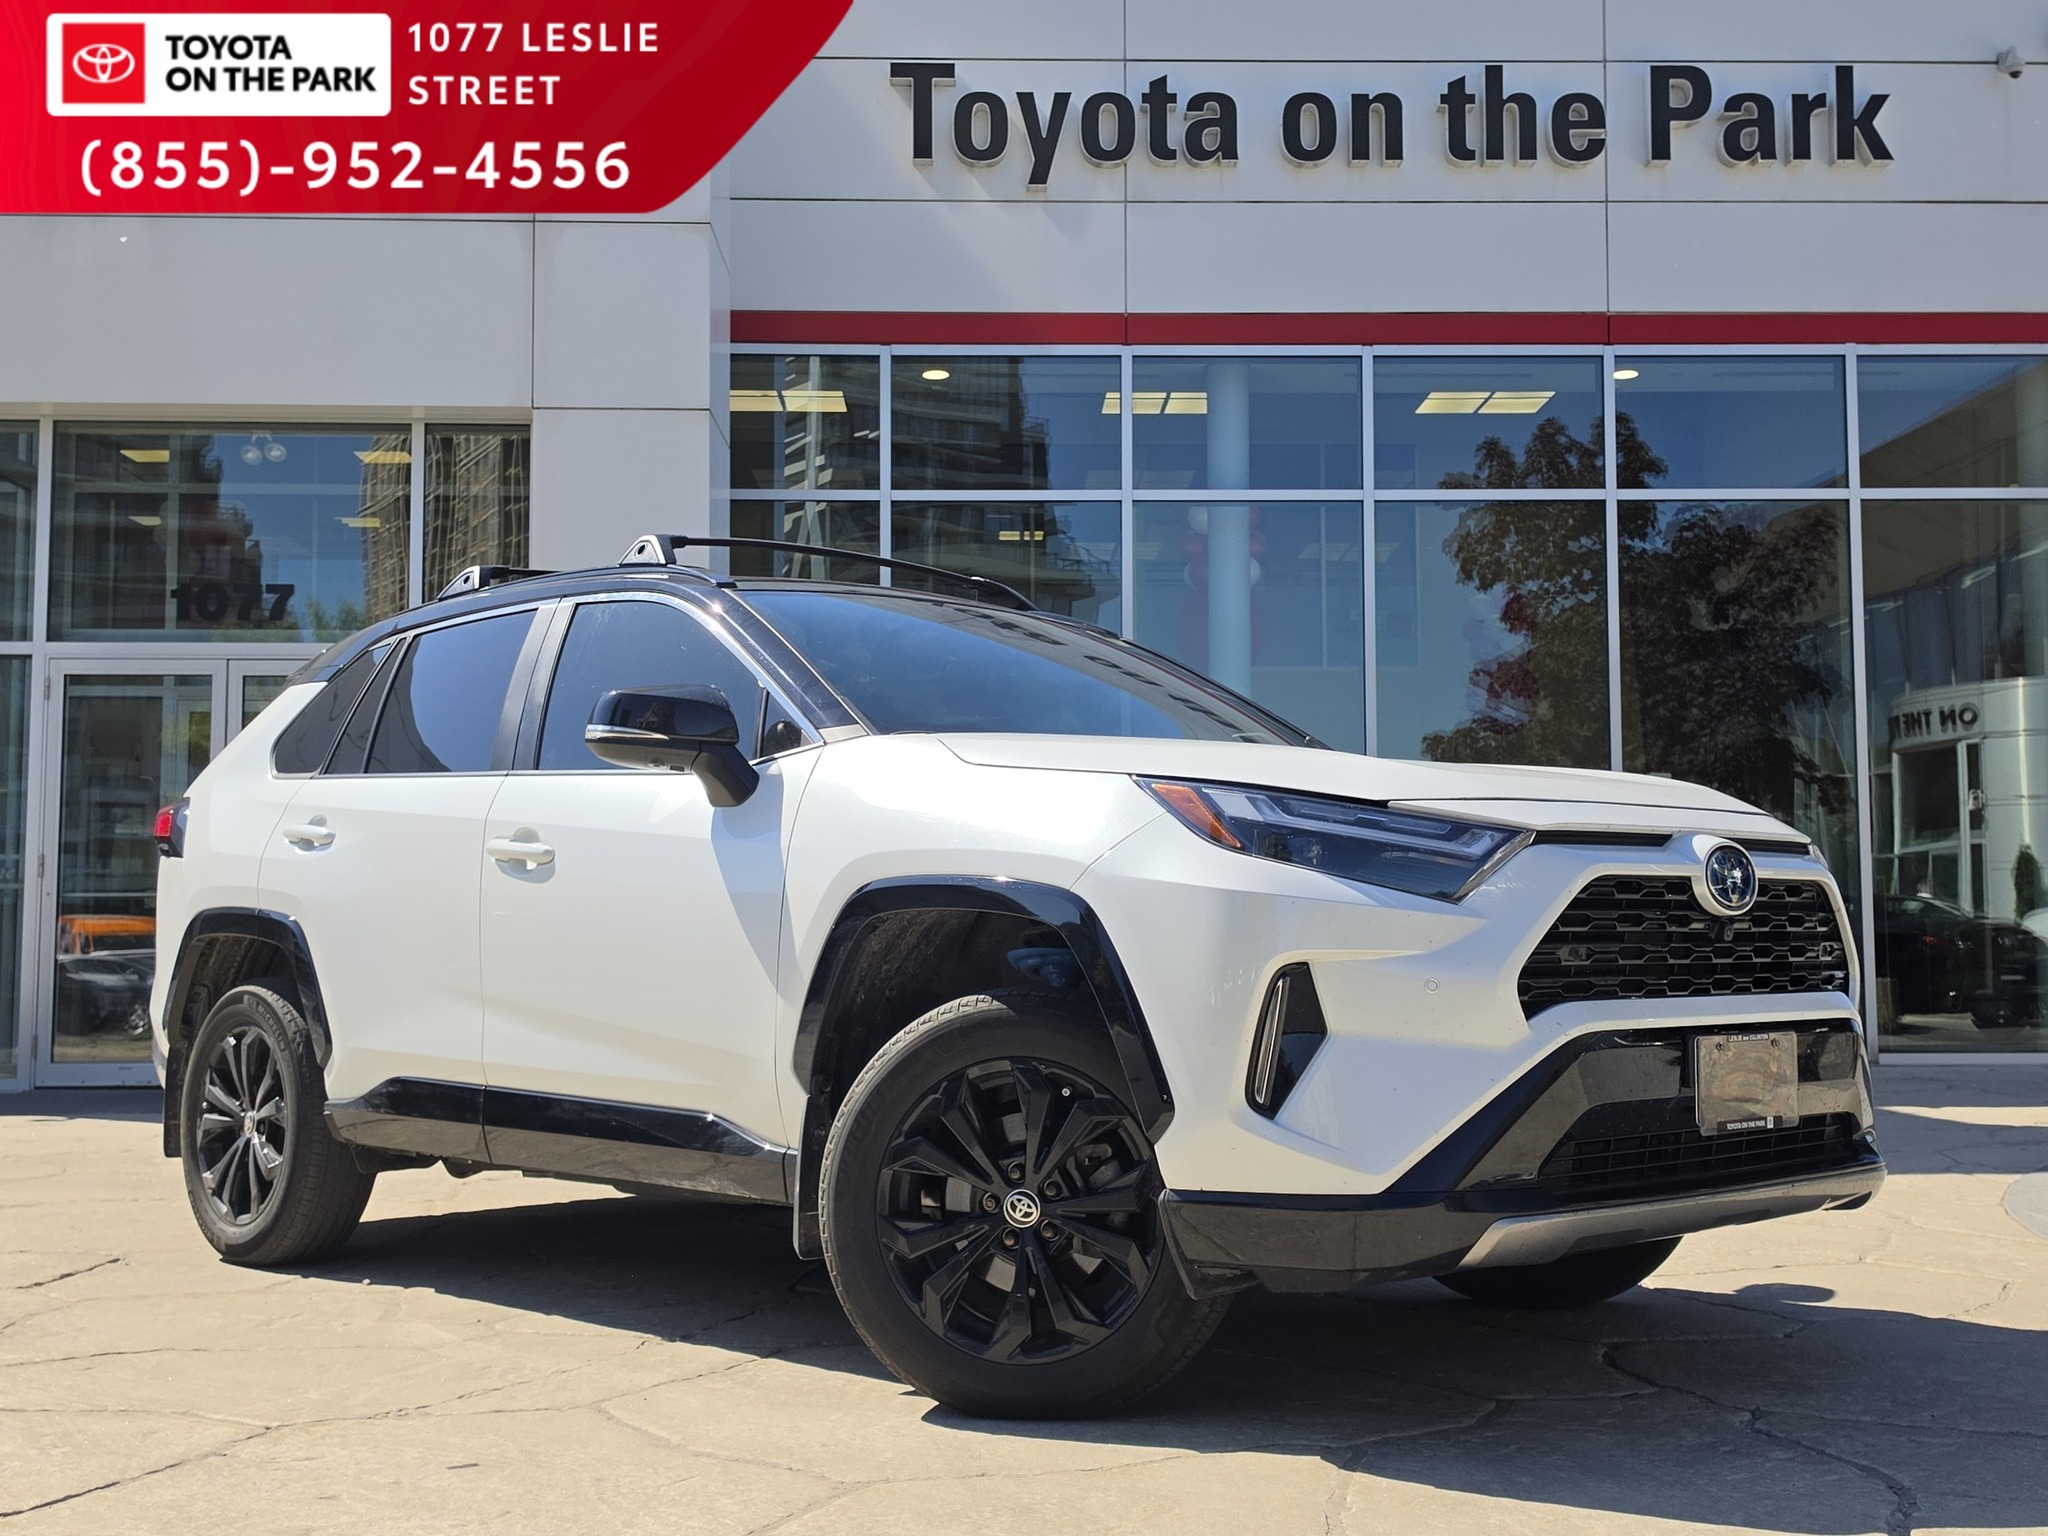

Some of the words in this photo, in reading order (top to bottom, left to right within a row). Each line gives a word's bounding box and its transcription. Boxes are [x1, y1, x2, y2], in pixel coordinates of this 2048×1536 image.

[890, 62, 1239, 187] Toyota
[1282, 92, 1404, 165] on
[1440, 64, 1606, 165] the
[1650, 65, 1893, 165] Park
[171, 583, 295, 621] 1077
